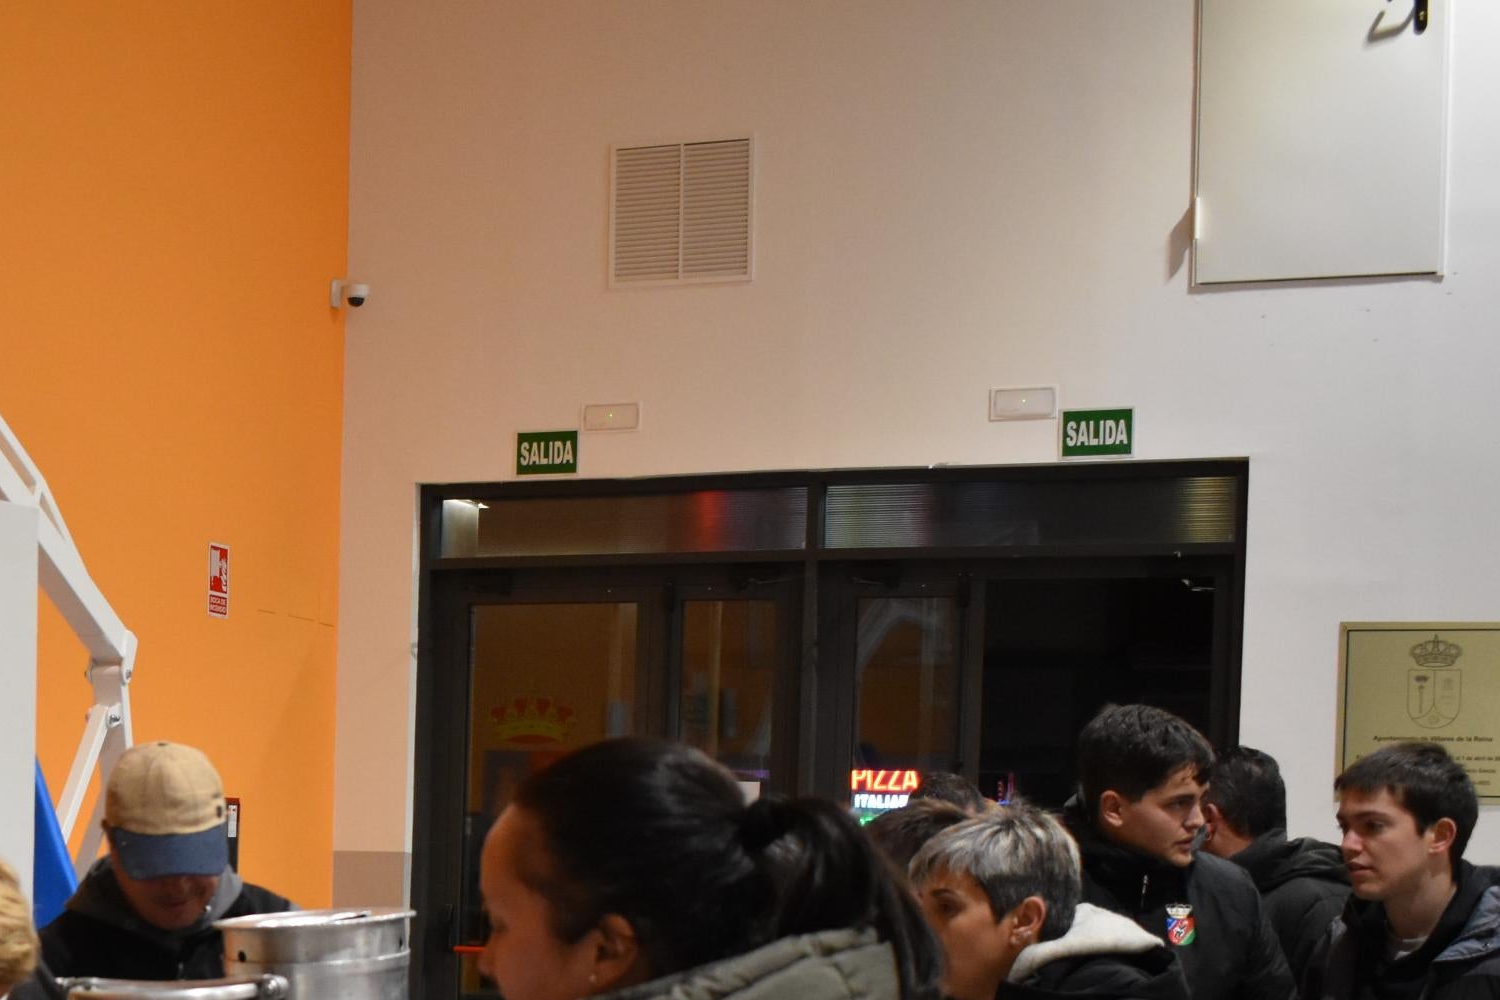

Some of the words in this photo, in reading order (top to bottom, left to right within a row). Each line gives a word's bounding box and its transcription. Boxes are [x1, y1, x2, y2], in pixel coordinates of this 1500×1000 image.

[1066, 419, 1127, 447] SALIDA
[520, 440, 573, 466] SALIDA
[851, 769, 919, 791] PIZZA
